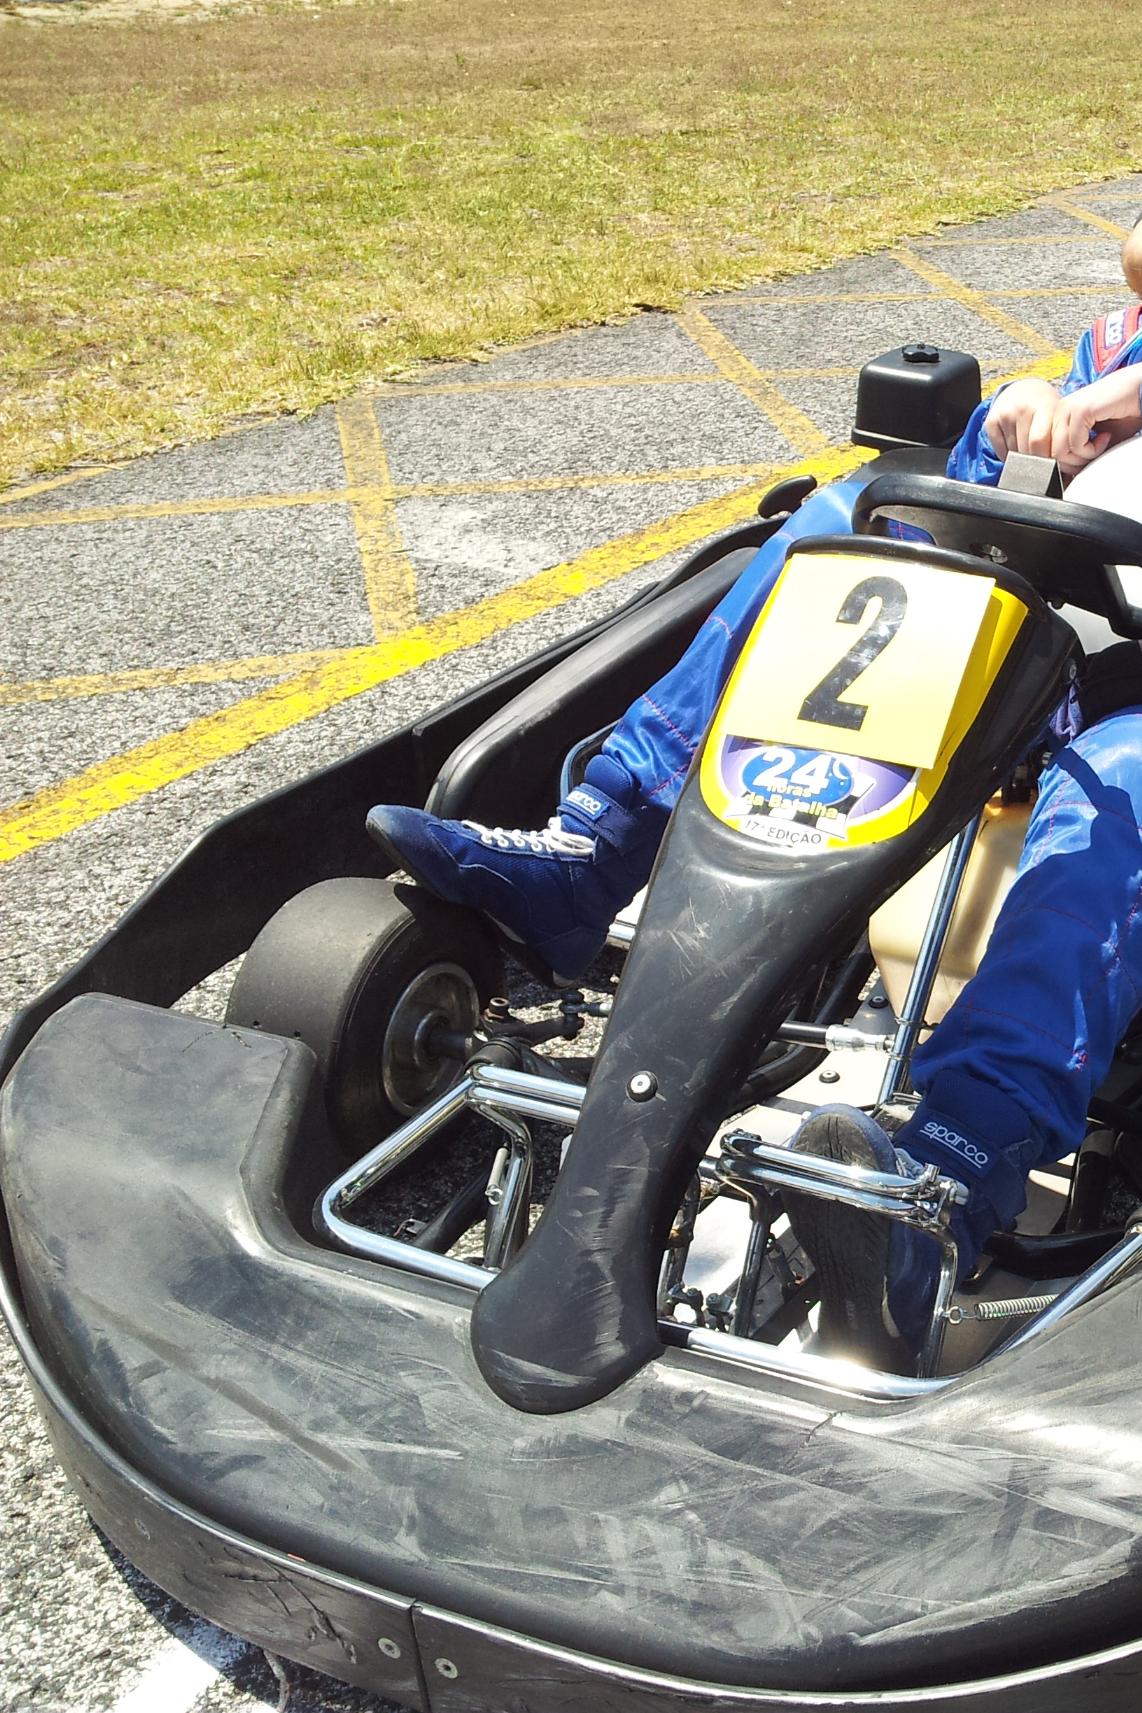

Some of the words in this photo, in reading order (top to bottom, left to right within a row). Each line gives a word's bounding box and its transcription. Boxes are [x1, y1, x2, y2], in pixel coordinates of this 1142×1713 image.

[797, 576, 908, 732] 2
[752, 745, 832, 794] 24
[744, 791, 764, 807] da
[767, 825, 822, 845] EDIÇÃO
[921, 1121, 988, 1166] sparco
